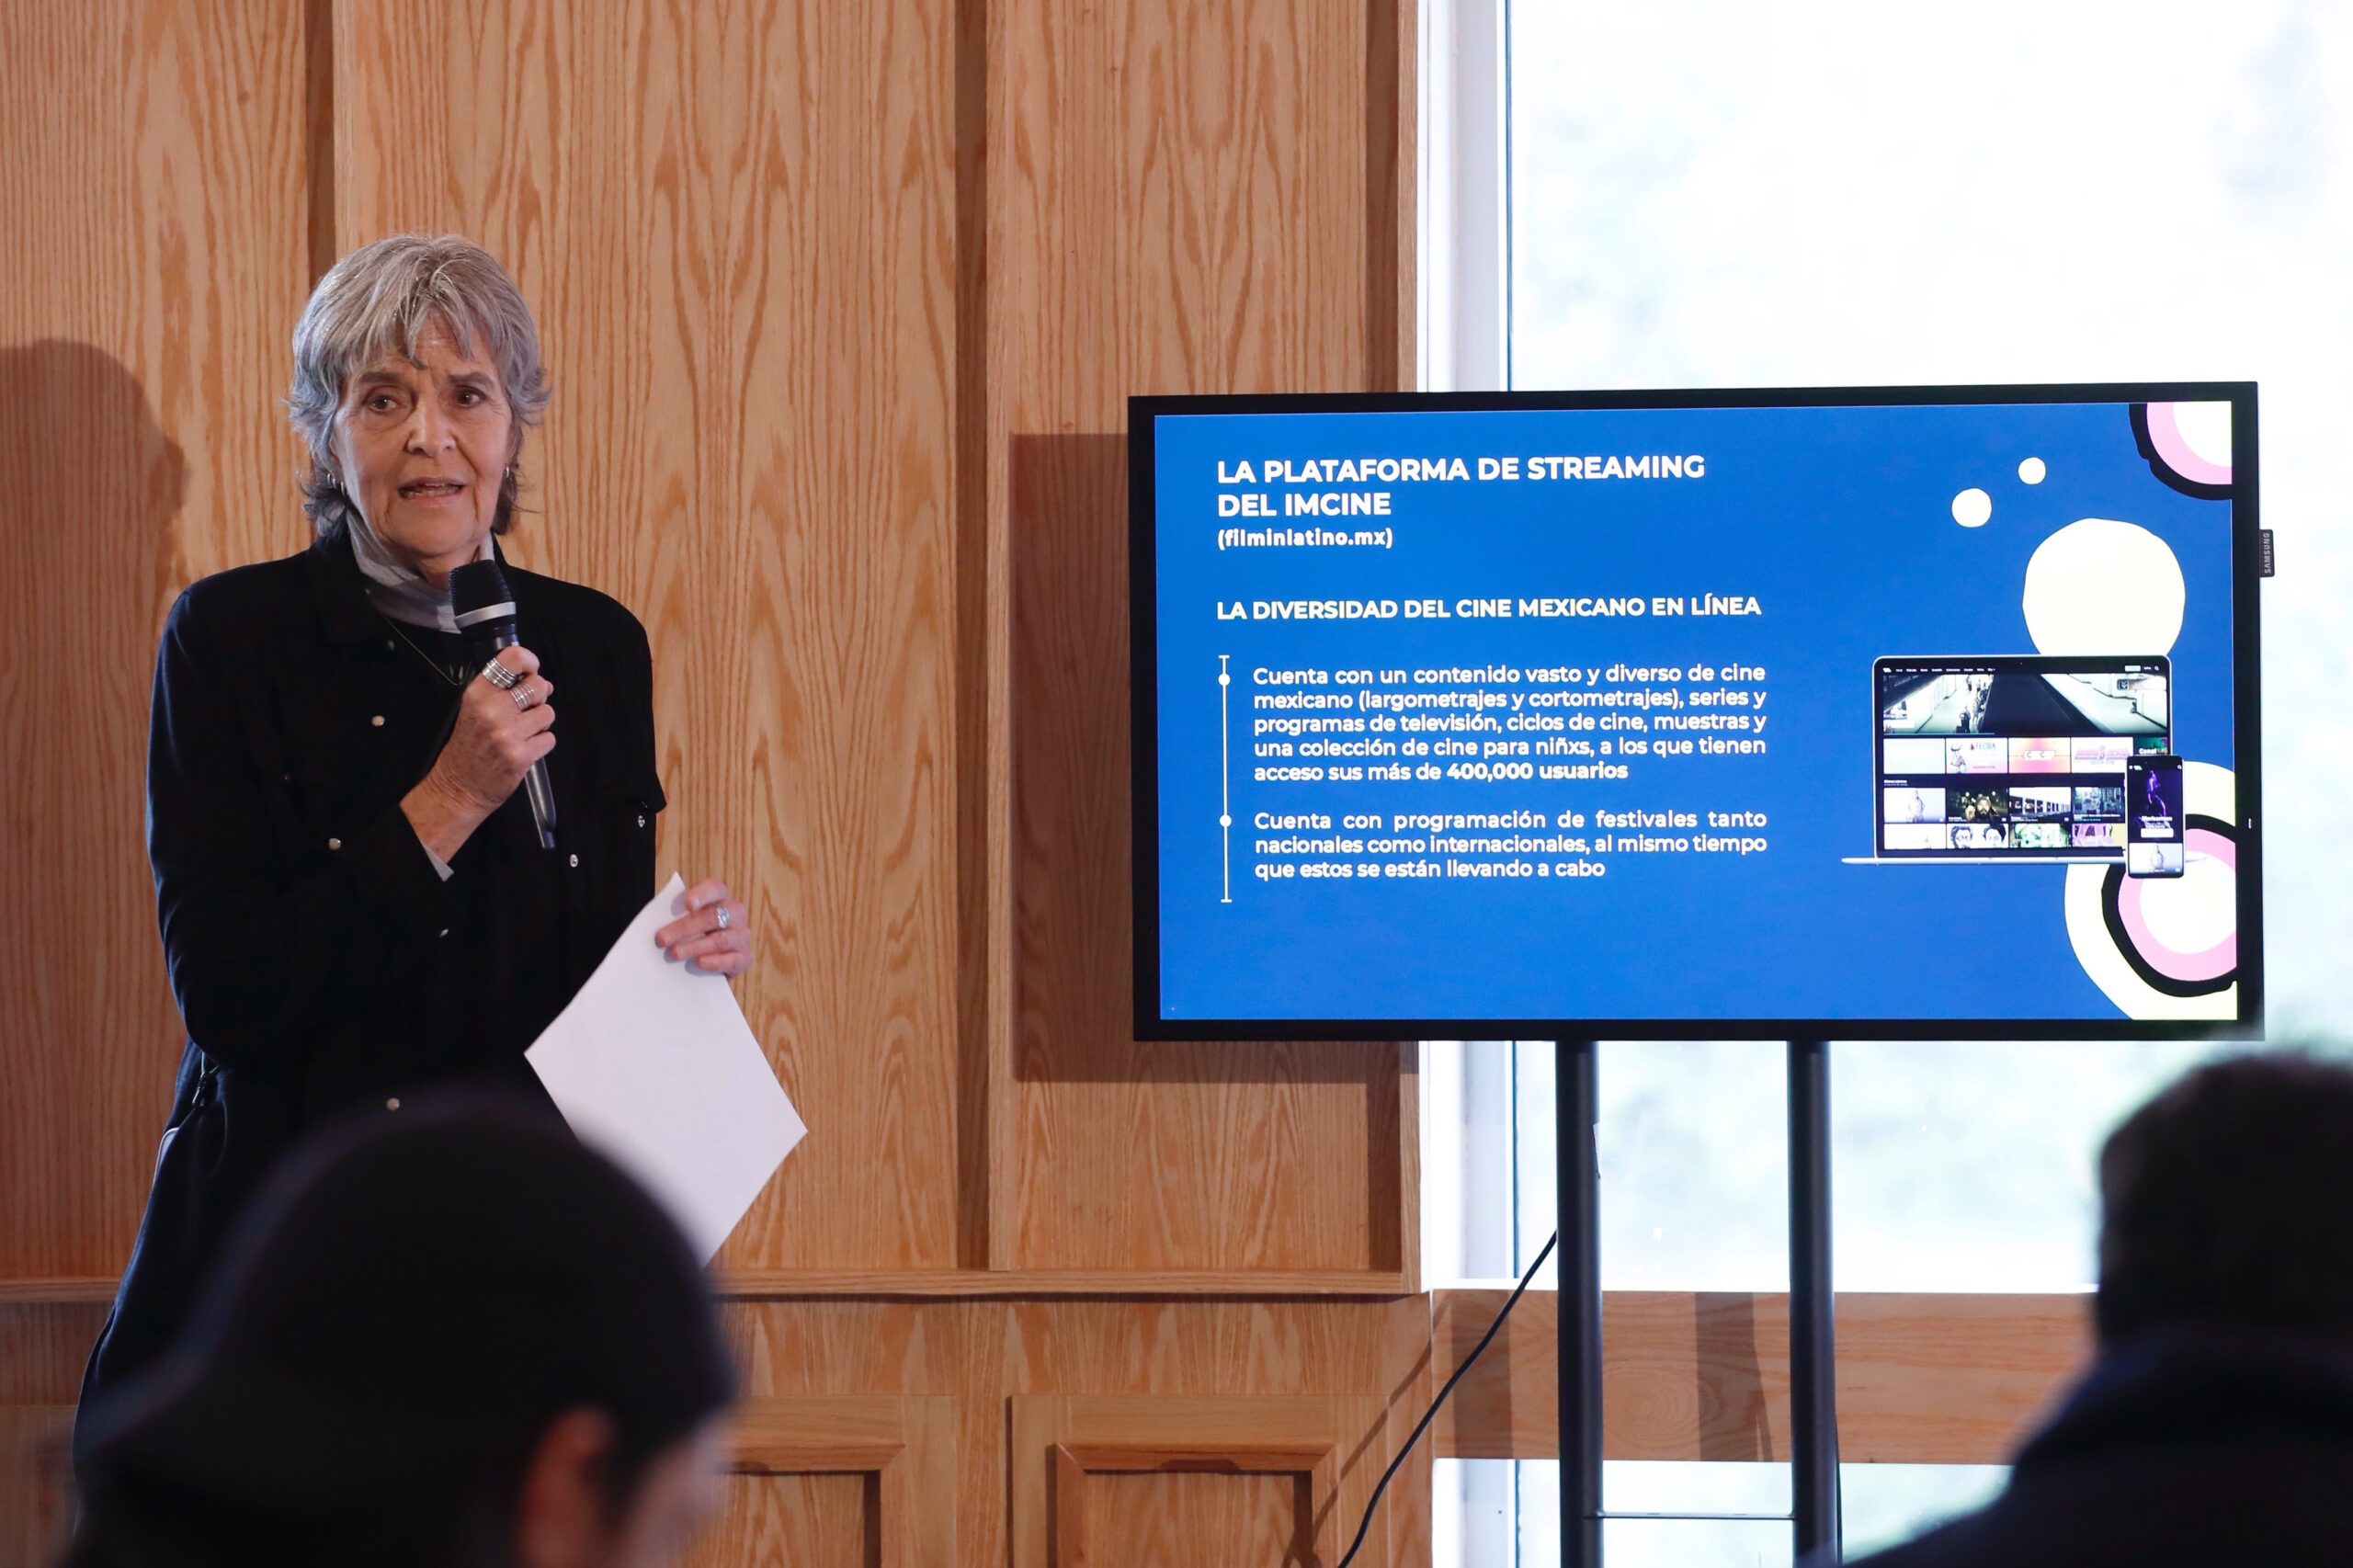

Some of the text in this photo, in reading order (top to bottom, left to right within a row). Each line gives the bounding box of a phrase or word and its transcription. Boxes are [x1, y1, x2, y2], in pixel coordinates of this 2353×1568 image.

[1217, 454, 1705, 484] LA PLATAFORMA DE STREAMING
[1218, 492, 1392, 517] DEL IMCINE
[1217, 527, 1393, 551] (filminlatino.mx)
[2262, 532, 2272, 574] SAMSUNG
[1217, 592, 1763, 620] LA DIVERSIDAD DEL CINE MEXICANO EN LÍNEA
[1253, 662, 1767, 687] Cuenta con un contenido vasto y diverso de cine
[1254, 687, 1768, 712] mexicano (largometrajes y cortometrajes), series y
[1254, 711, 1768, 737] programas de televisión, ciclos de cine, muestras y
[1254, 735, 1767, 760] una colección de cine para niñxs, a los que tienen
[1254, 760, 1630, 783] acceso sus más de 400,000 usuarios
[1254, 809, 1768, 834] Cuenta con programación de festivales tanto
[1255, 833, 1768, 856] nacionales como internacionales, al mismo tiempo
[1255, 858, 1606, 882] que estos se están llevando a cabo
